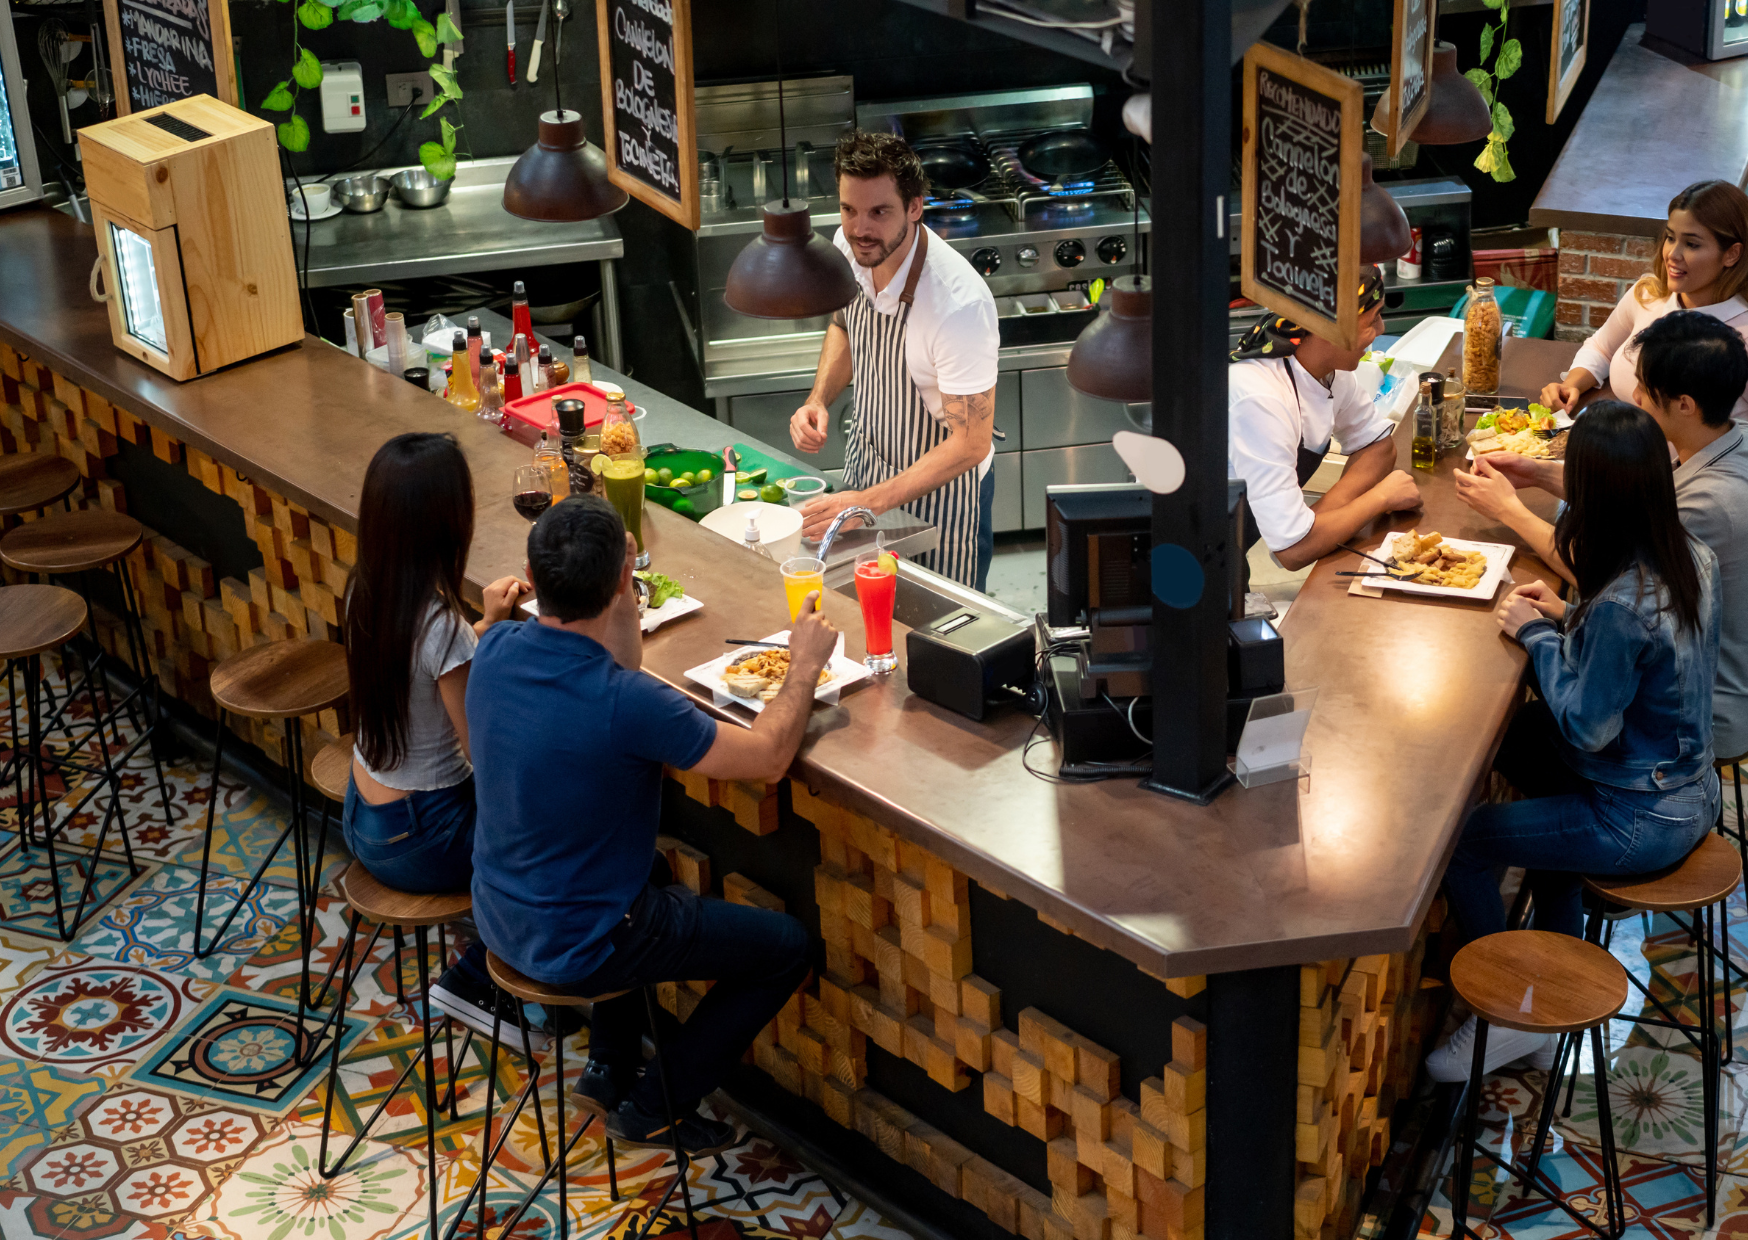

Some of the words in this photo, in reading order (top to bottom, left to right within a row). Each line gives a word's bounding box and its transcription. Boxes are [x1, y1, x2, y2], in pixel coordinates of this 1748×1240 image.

[129, 9, 213, 72] MANDARINA
[132, 37, 176, 73] FRESA
[136, 60, 192, 96] LYCHEE
[633, 60, 655, 97] DE
[1260, 72, 1340, 133] RECOMENDADO
[1286, 167, 1311, 199] de
[1261, 180, 1337, 242] Bolognesa
